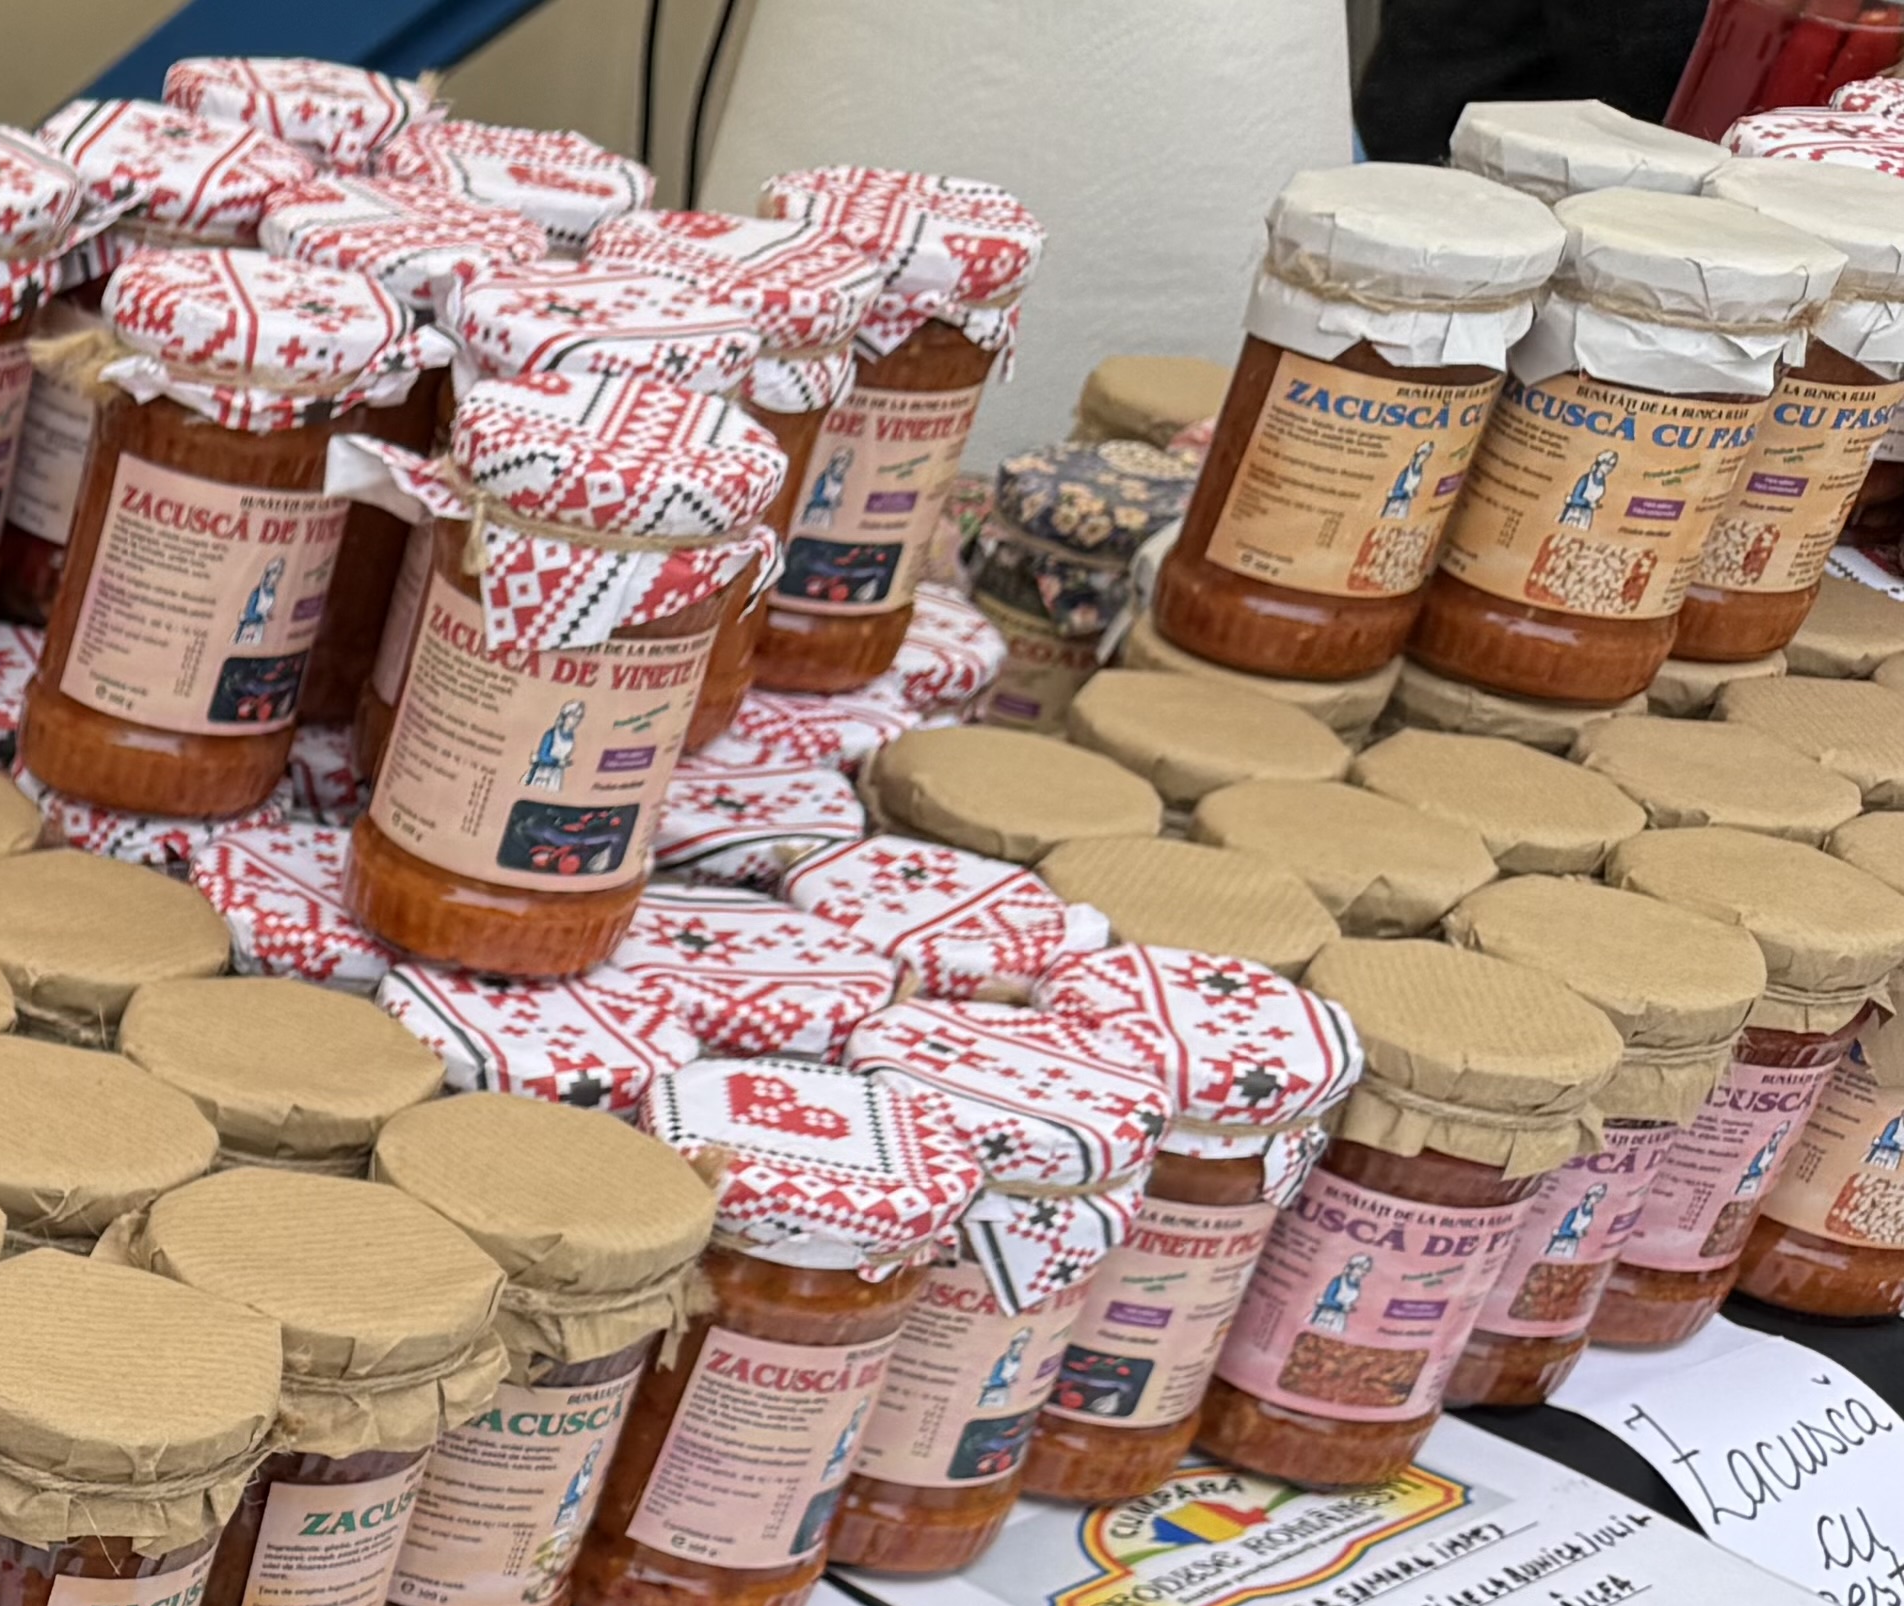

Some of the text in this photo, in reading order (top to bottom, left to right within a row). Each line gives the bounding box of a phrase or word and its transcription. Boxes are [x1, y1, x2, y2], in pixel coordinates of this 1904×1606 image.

[1286, 379, 1450, 430] ZACUSCĂ
[1774, 402, 1823, 428] CU
[1652, 424, 1702, 449] CU
[258, 518, 296, 545] DE
[551, 657, 599, 688] DE
[1420, 1234, 1480, 1257] DE
[705, 1347, 849, 1394] ZACUSCĂ
